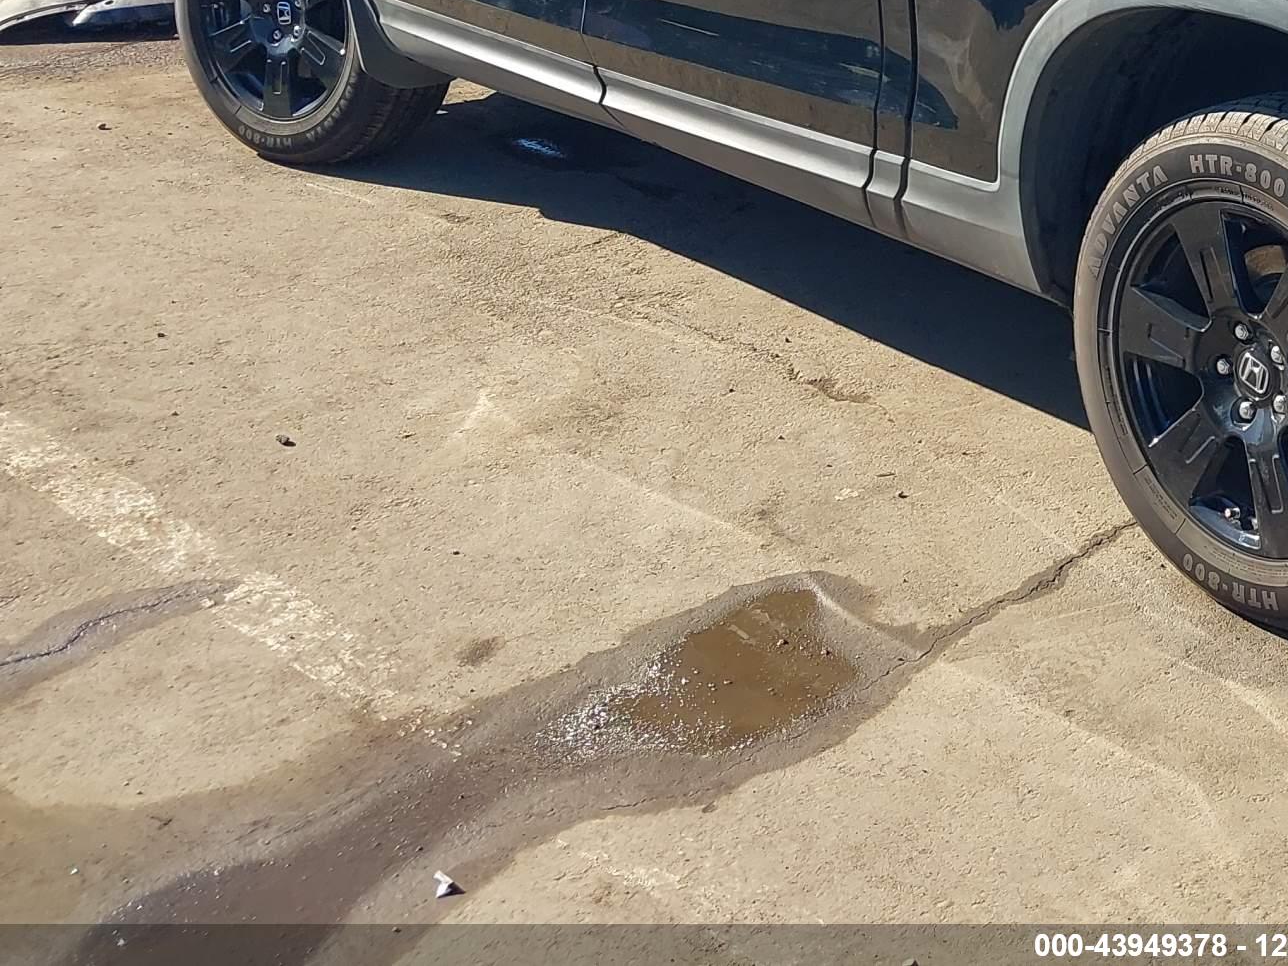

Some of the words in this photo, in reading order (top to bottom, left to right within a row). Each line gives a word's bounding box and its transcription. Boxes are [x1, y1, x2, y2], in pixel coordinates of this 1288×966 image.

[1088, 165, 1168, 280] ADVANTA
[1189, 154, 1286, 197] HTR-800
[1183, 553, 1279, 611] HTR-800
